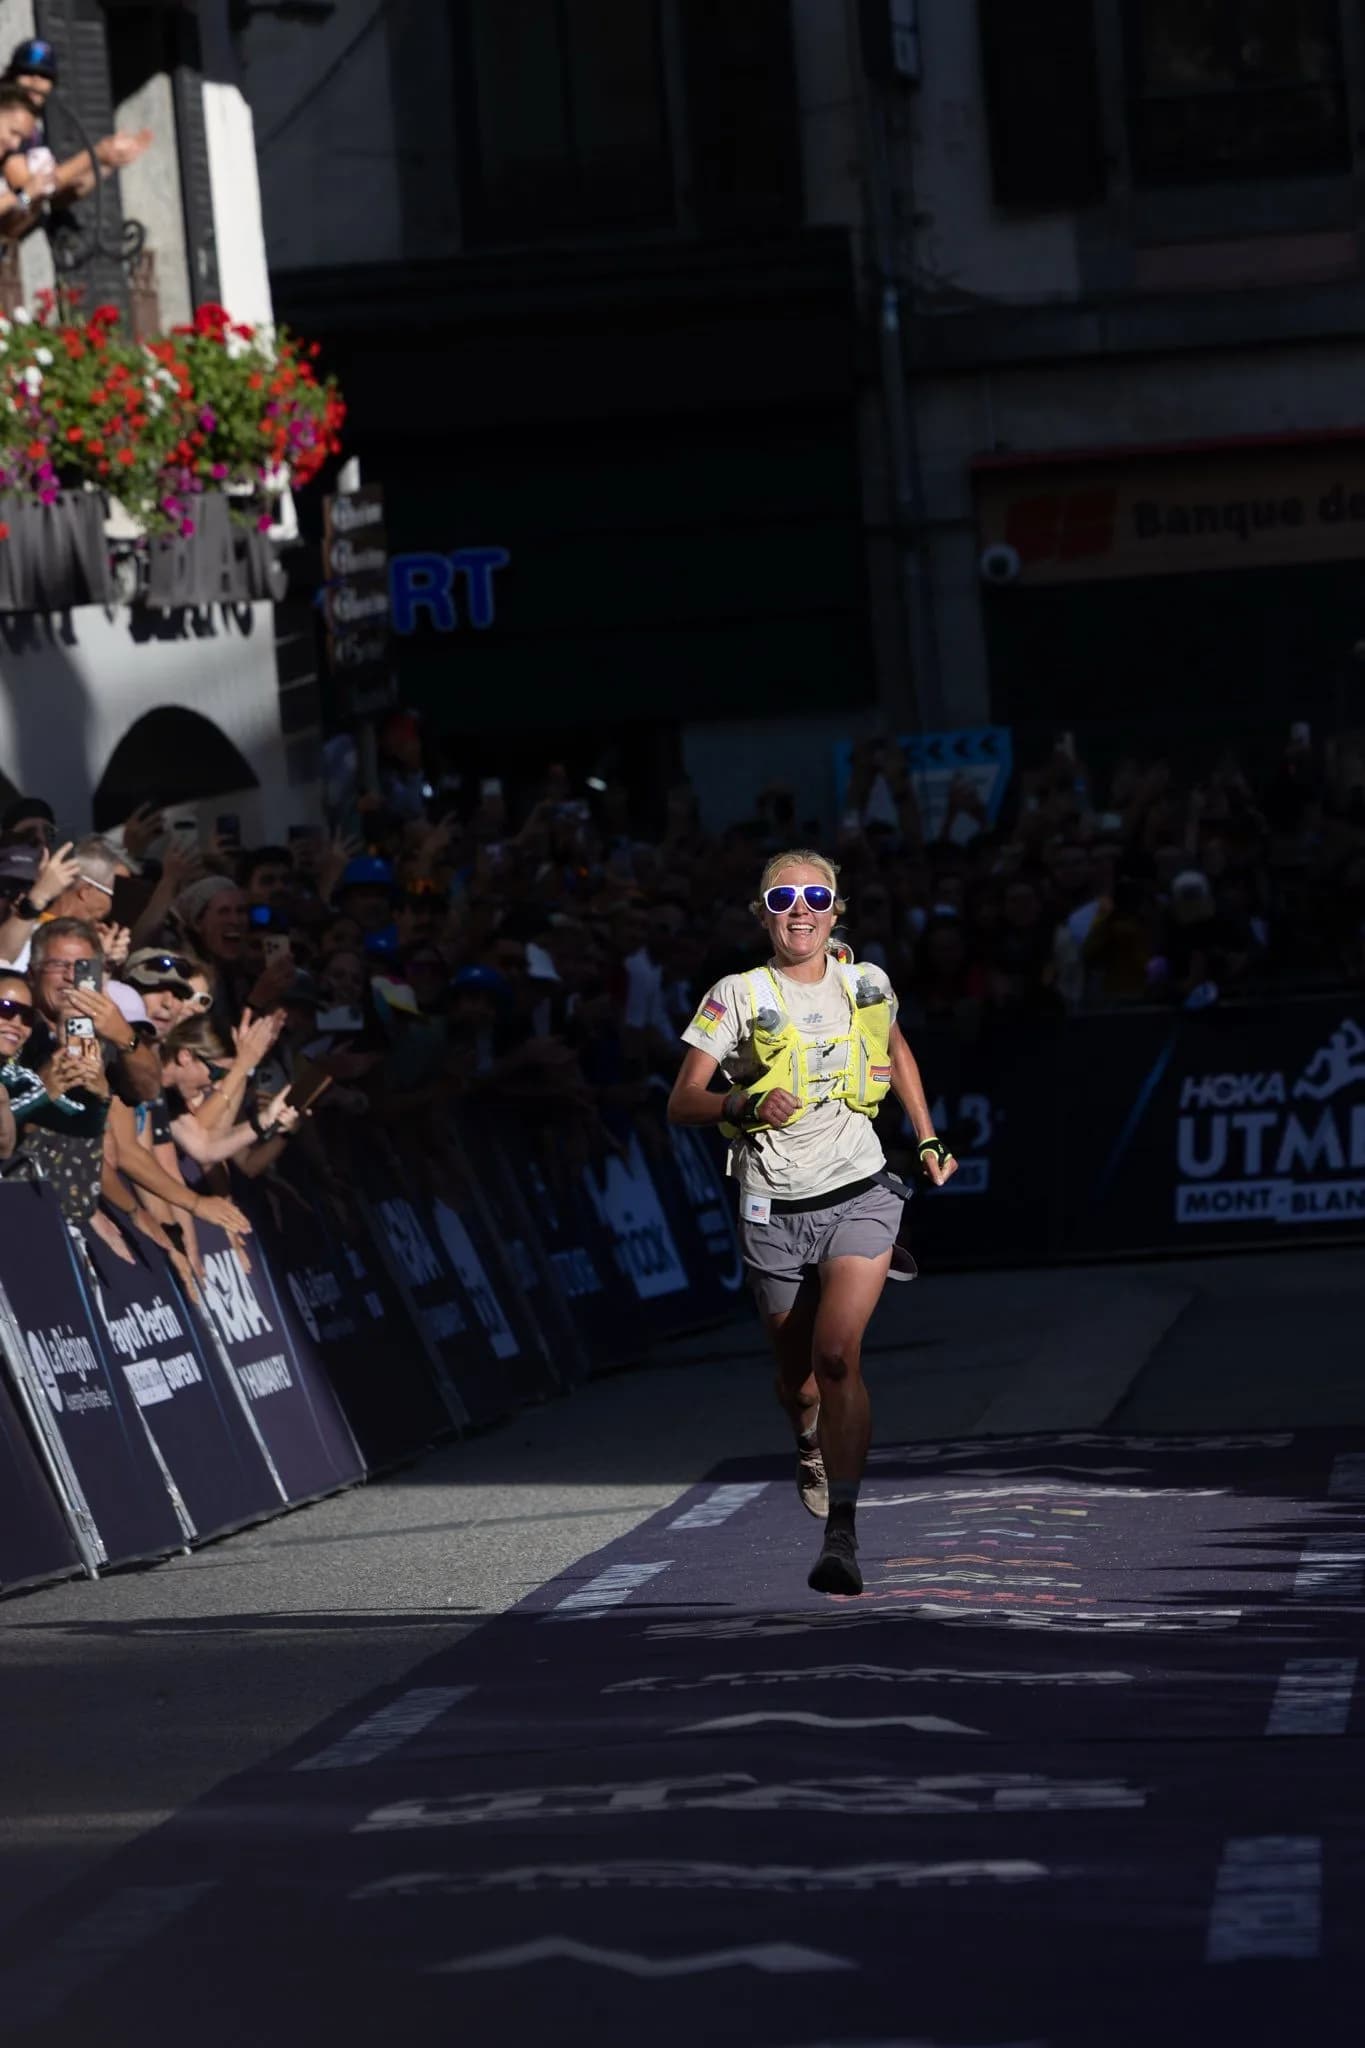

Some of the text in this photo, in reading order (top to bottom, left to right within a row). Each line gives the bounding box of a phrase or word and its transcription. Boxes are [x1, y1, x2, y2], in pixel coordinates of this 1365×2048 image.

[1133, 497, 1304, 542] Banque
[1178, 1071, 1287, 1111] HOKA
[1176, 1103, 1365, 1179] UTM
